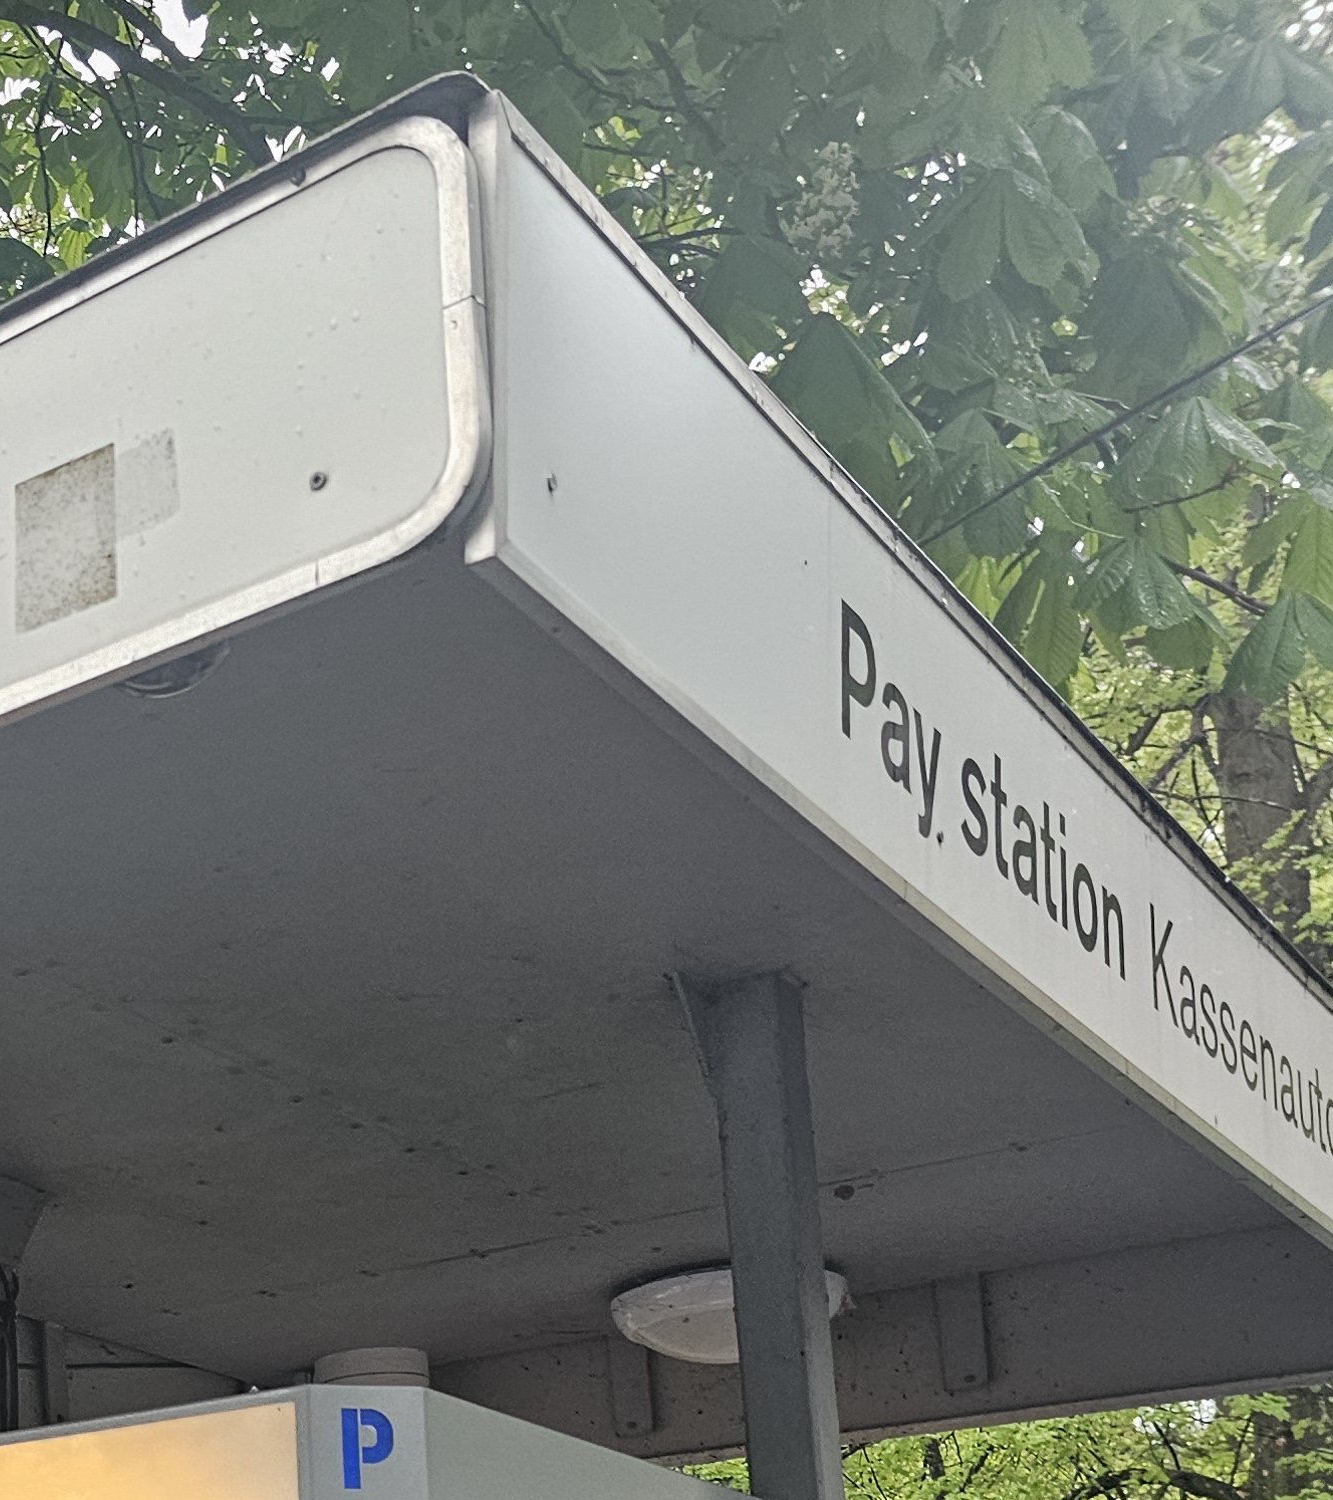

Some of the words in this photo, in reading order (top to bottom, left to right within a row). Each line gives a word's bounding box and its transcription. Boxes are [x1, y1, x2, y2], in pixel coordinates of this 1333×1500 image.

[841, 598, 941, 838] Pay
[961, 753, 1126, 981] station
[340, 1408, 394, 1490] P
